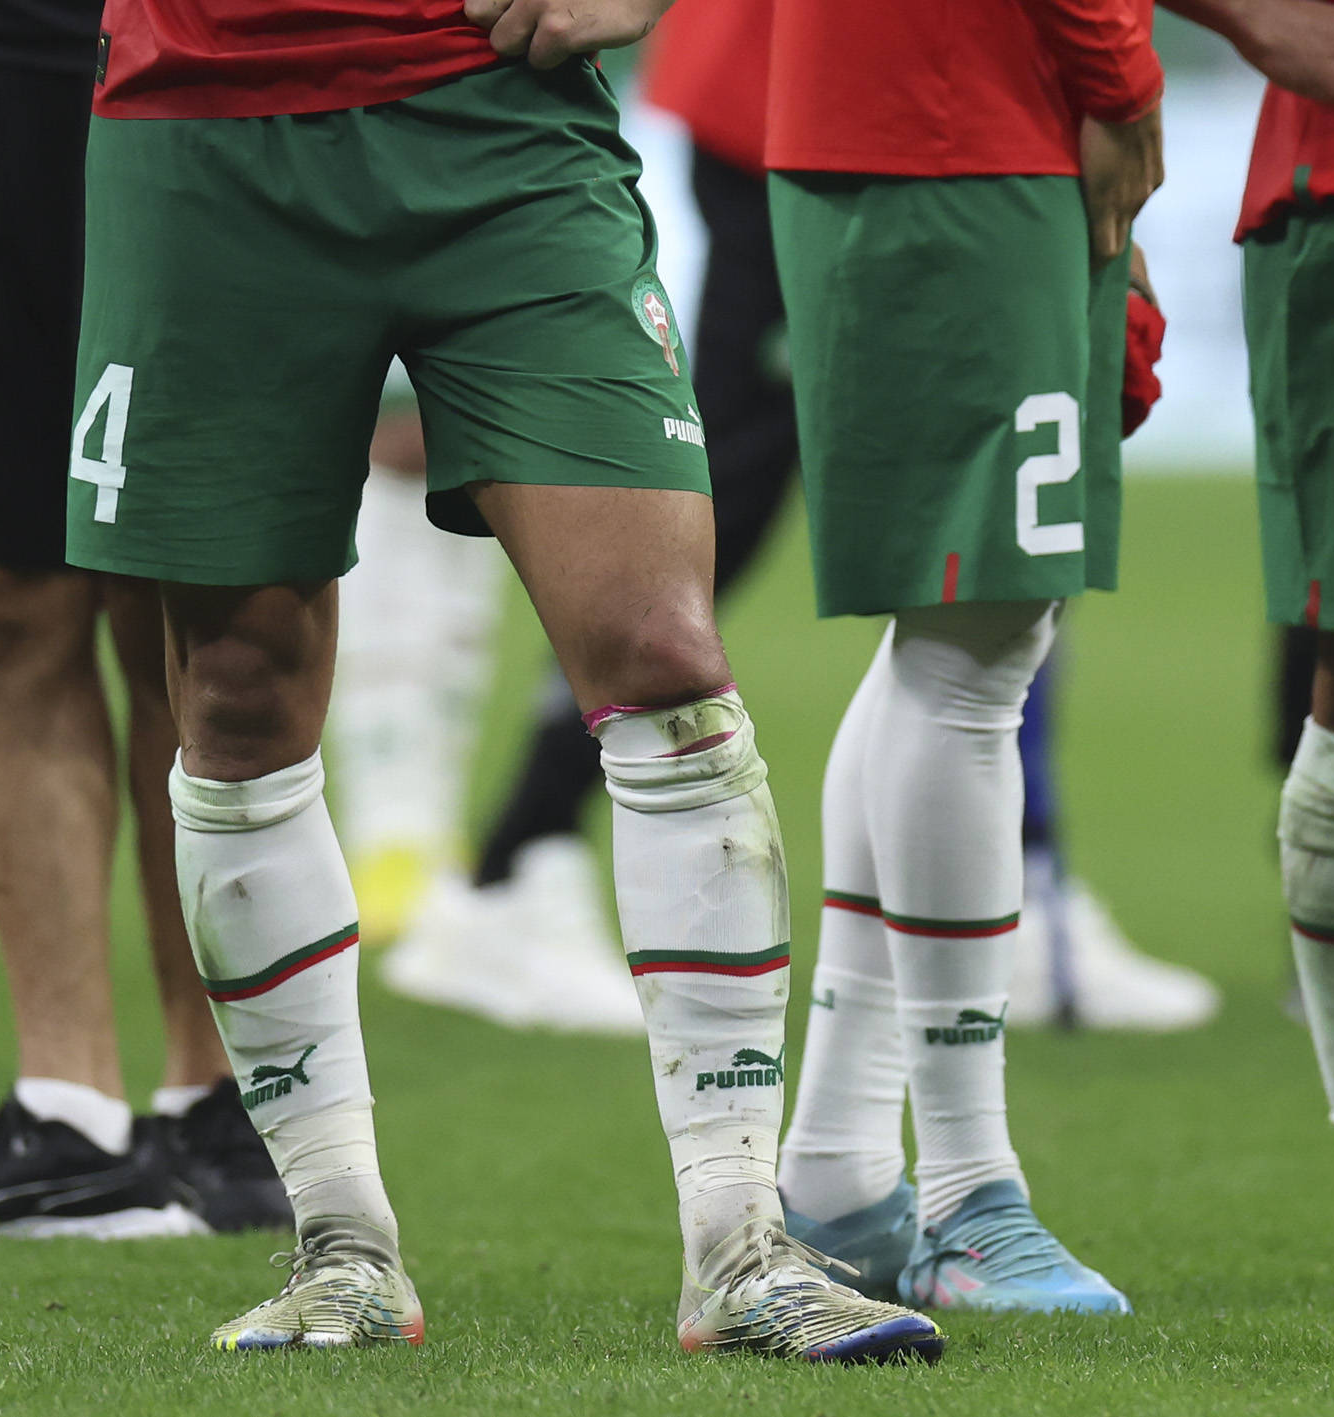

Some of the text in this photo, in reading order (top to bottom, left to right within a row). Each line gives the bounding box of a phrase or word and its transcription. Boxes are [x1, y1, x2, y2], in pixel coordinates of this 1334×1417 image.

[70, 363, 134, 524] 4
[1015, 392, 1084, 556] 2
[696, 1069, 777, 1091] PUMA
